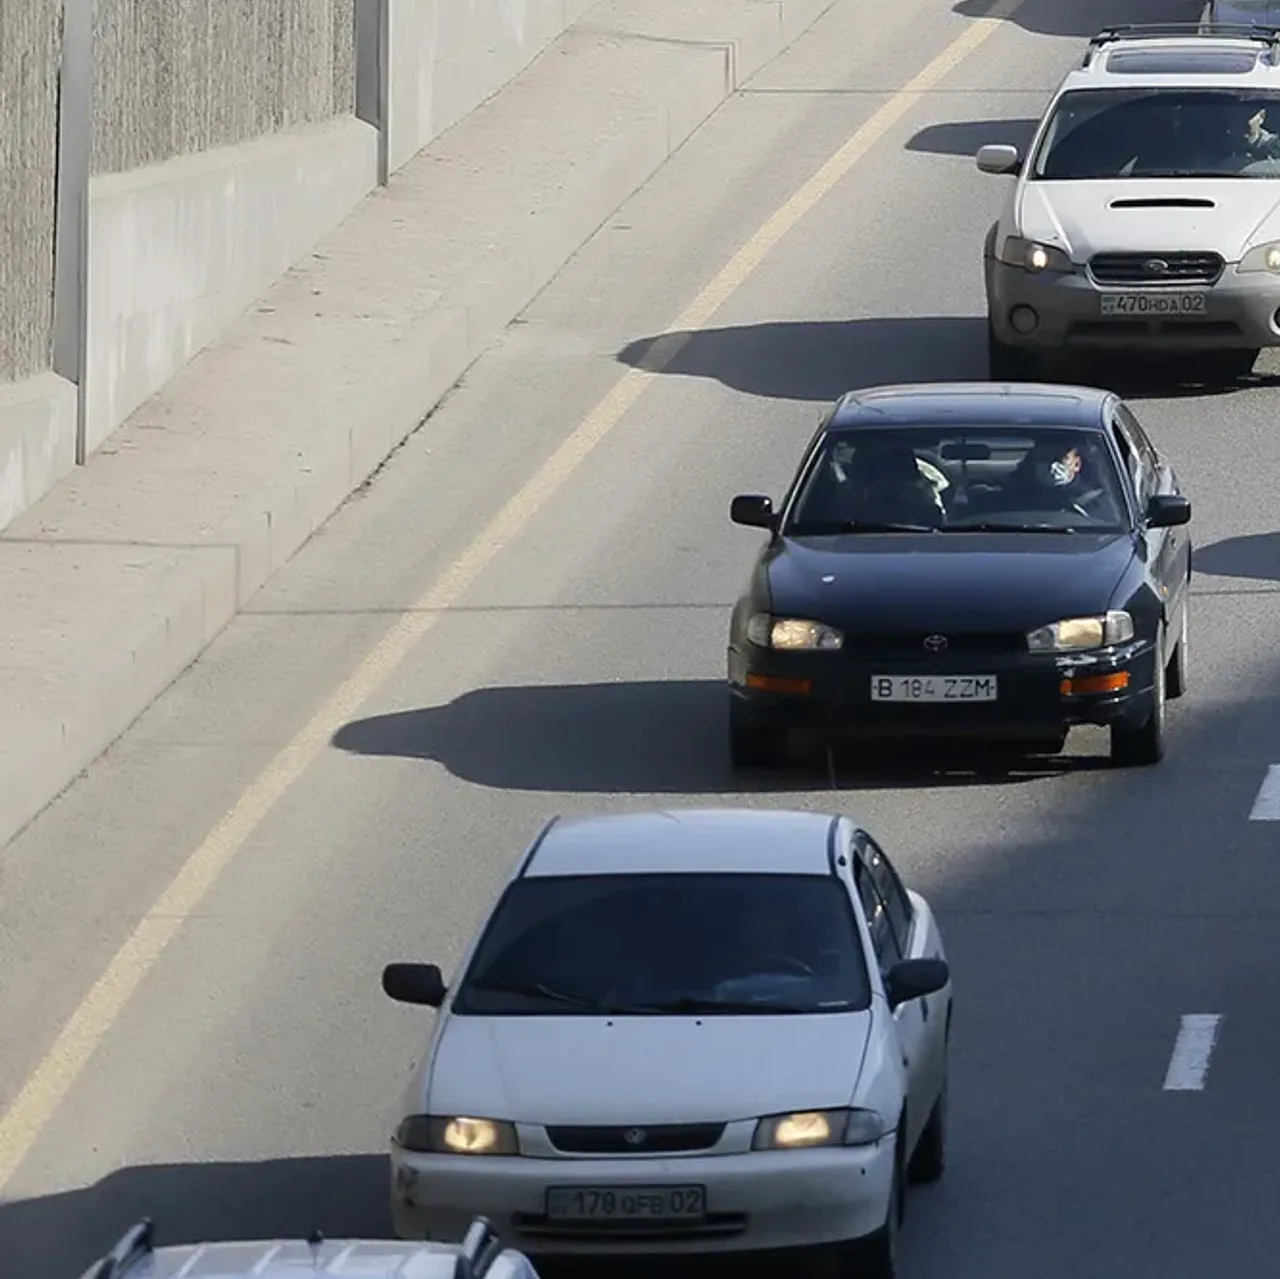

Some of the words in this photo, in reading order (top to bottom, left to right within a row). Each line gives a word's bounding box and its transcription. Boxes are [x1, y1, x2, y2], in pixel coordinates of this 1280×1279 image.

[1182, 294, 1204, 311] 02
[877, 677, 894, 698] B
[900, 678, 936, 698] 184
[943, 677, 991, 698] ZZM
[669, 1189, 701, 1214] 02
